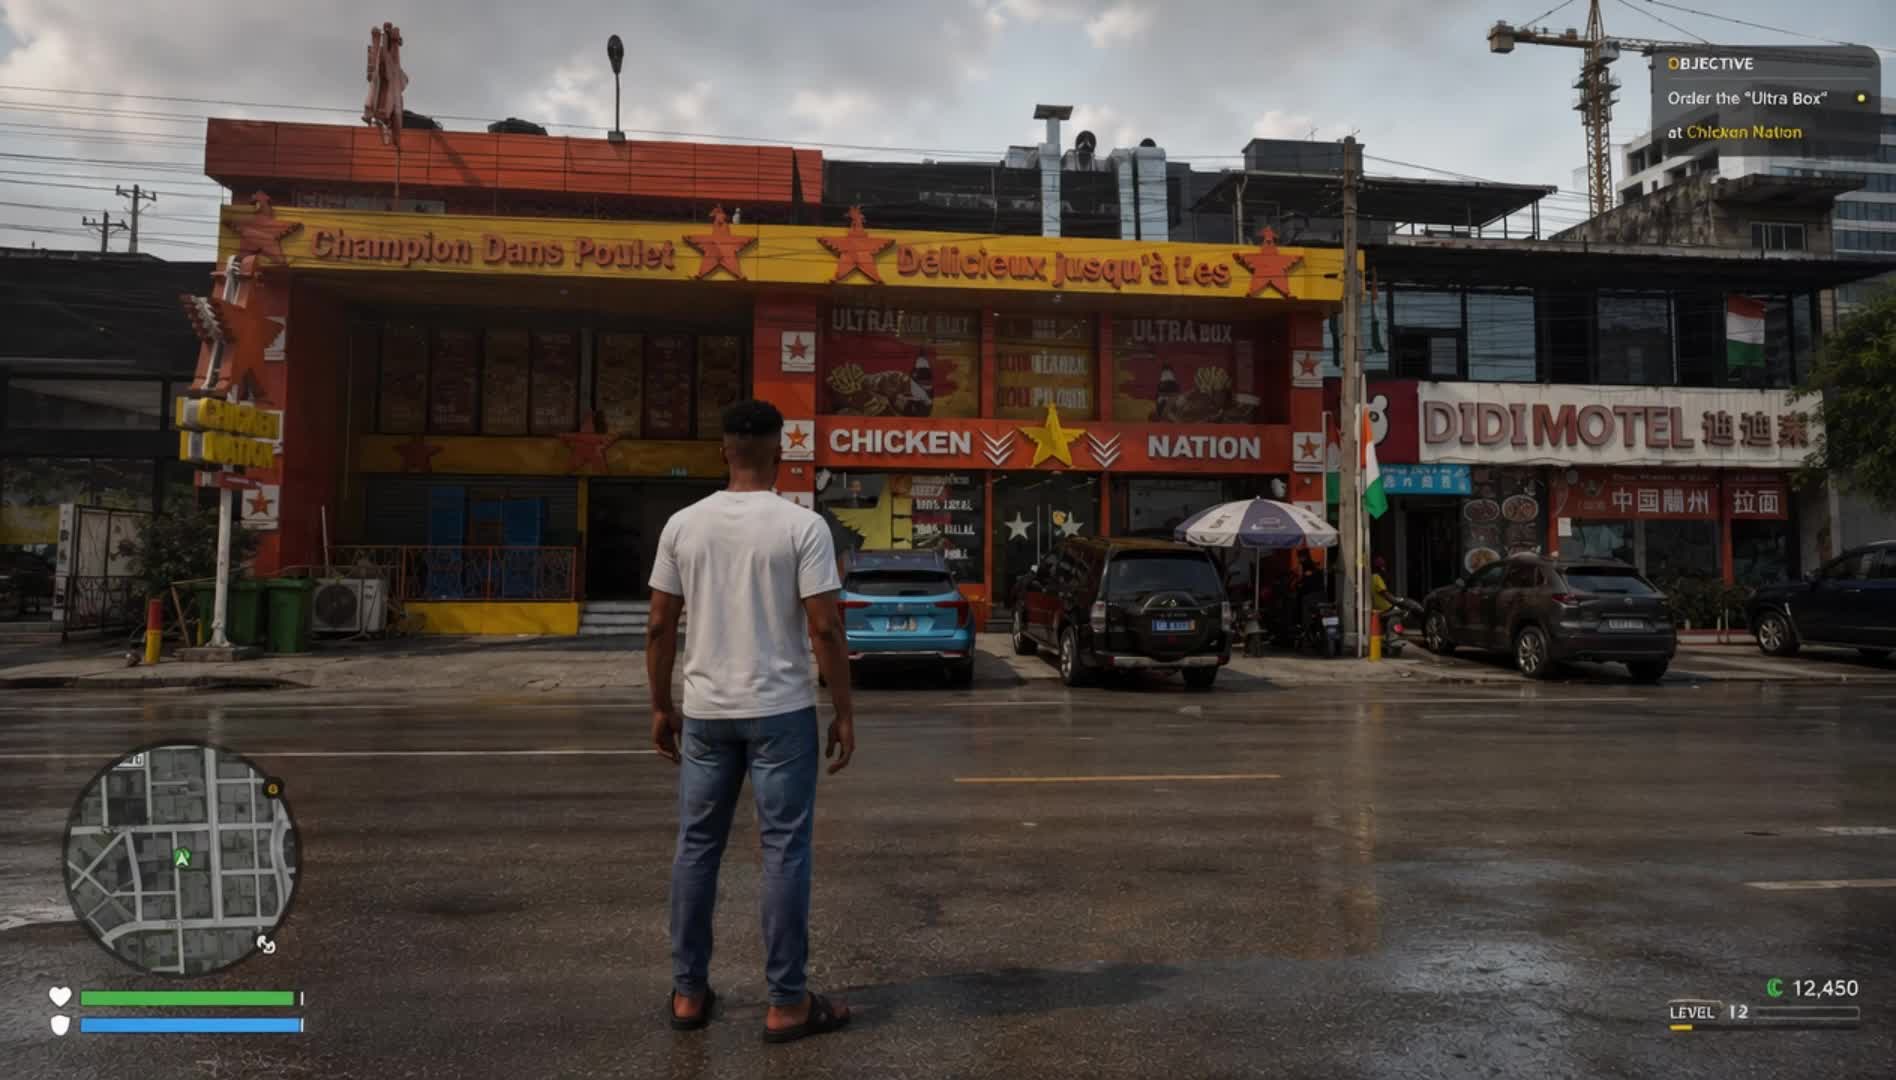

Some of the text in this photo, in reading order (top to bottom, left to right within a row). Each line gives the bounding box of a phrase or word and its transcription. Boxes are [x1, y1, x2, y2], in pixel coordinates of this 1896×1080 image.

[311, 229, 676, 270] Champion Dans Poulet
[1133, 319, 1196, 344] ULTRA
[829, 428, 973, 455] CHICKEN
[1147, 434, 1263, 460] NATION
